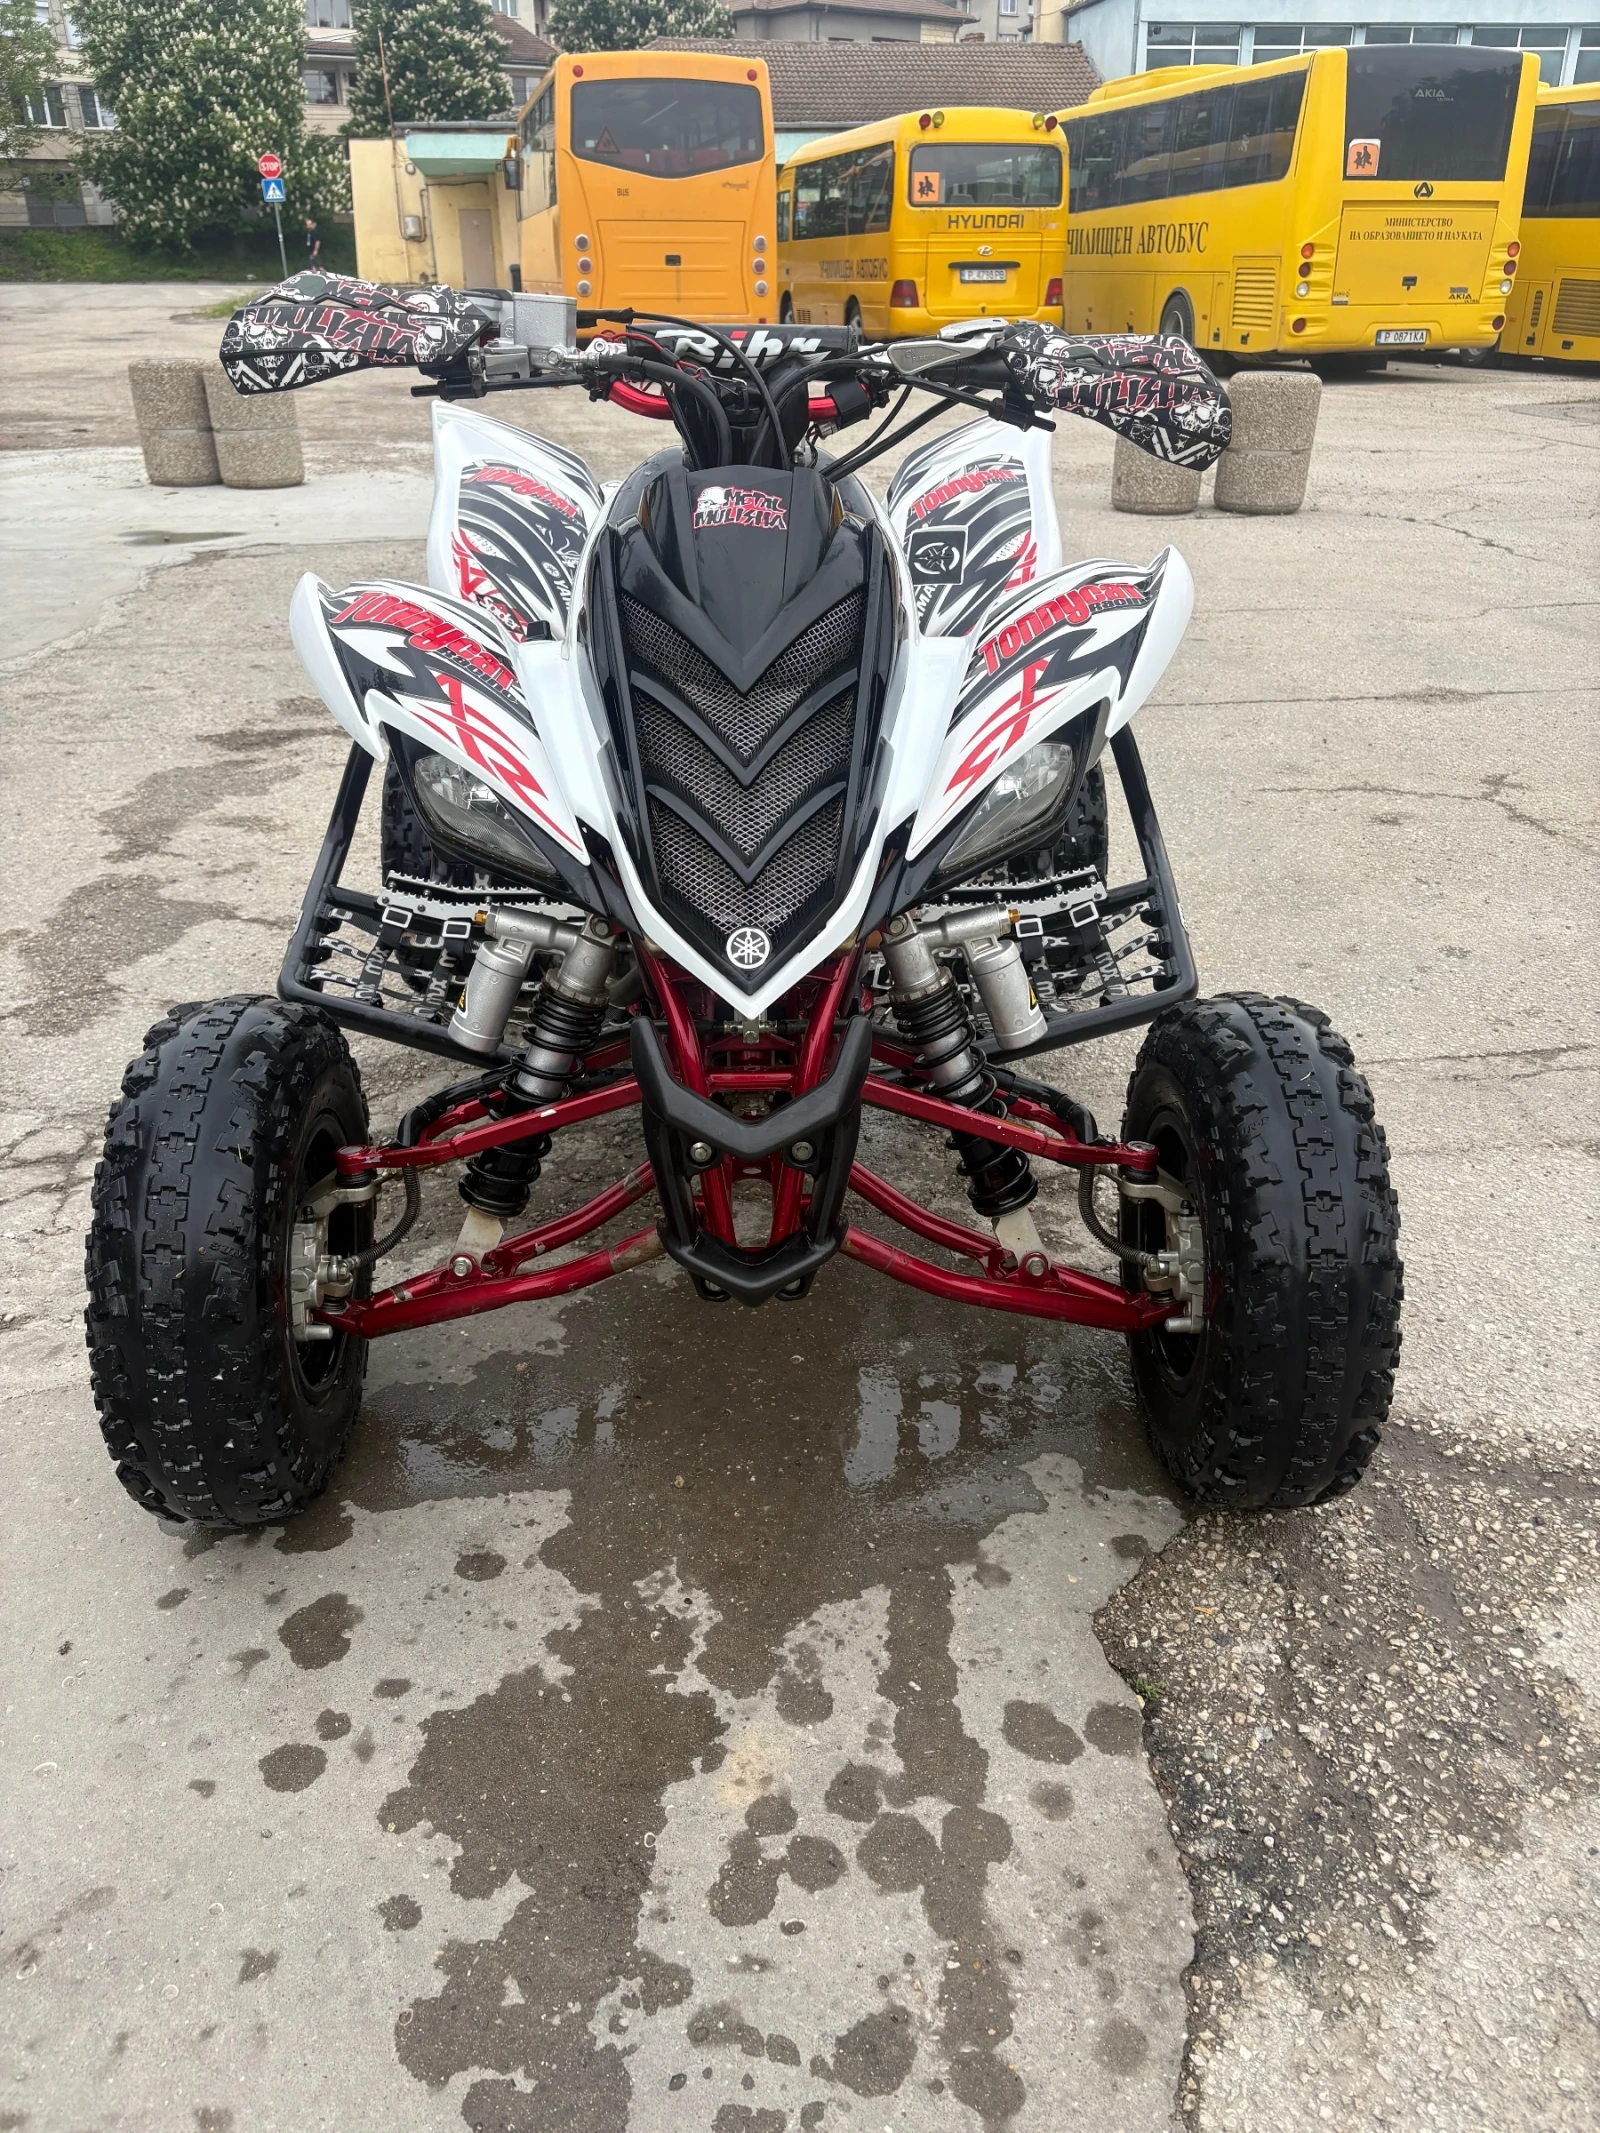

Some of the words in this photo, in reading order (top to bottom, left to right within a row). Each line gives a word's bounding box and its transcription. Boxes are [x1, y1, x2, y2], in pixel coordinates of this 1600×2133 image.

[1415, 89, 1445, 98] AKIA
[260, 162, 279, 171] STOP
[948, 214, 1024, 229] HYUNDAI
[1385, 217, 1453, 227] МИНИСТЕРСТВО
[1067, 226, 1133, 257] ЧИЛИЩЕН
[1137, 221, 1209, 254] АВТОБУС
[1350, 231, 1361, 241] НА
[1363, 231, 1435, 241] ОБРАЗОВАНИЕТО
[1436, 231, 1443, 241] И
[1444, 231, 1482, 241] НАУКАТА
[1089, 597, 1147, 614] Racin
[480, 596, 520, 631] Spider
